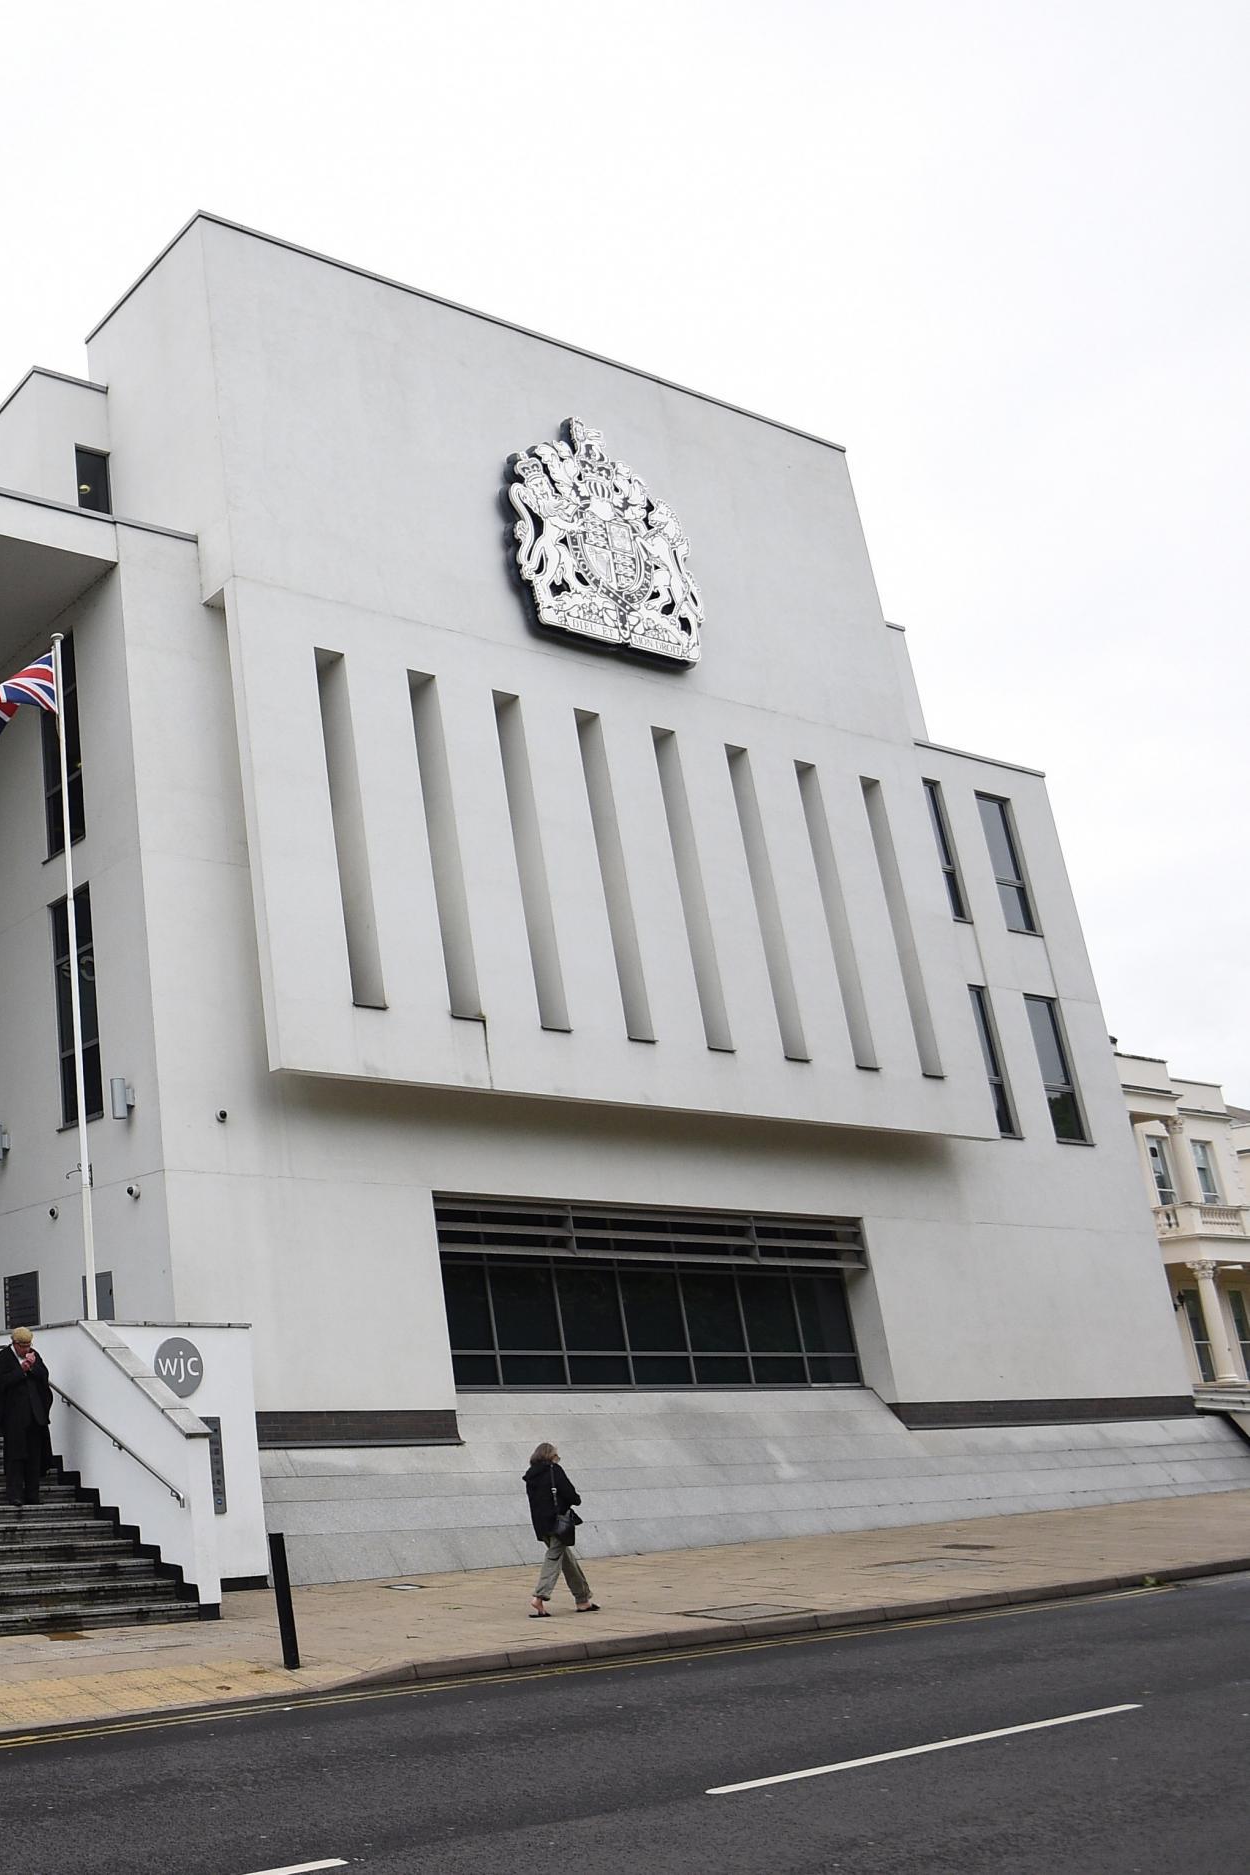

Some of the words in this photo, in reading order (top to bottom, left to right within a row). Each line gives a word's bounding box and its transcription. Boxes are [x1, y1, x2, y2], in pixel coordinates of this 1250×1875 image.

[572, 618, 597, 633] DIEU
[603, 627, 614, 638] ET
[634, 635, 651, 648] MON
[655, 640, 681, 655] DROIT
[158, 1351, 199, 1383] wjc
